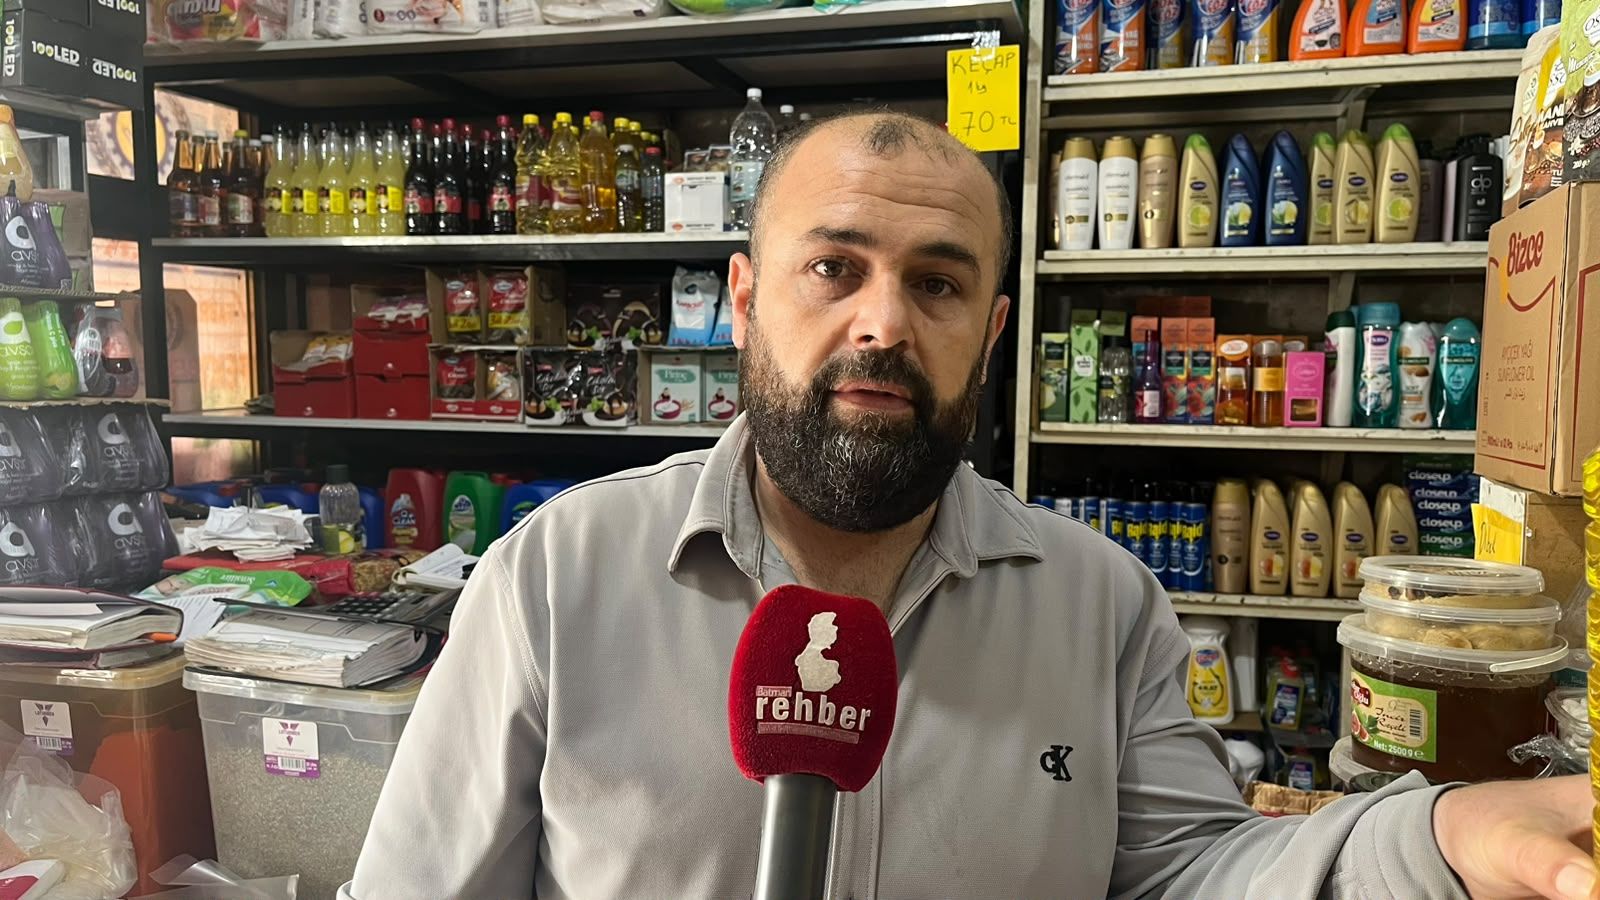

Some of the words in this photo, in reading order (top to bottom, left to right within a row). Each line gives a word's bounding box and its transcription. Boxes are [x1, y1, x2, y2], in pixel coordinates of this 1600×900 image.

[2, 18, 16, 77] 100LED
[31, 40, 81, 67] 100LED
[92, 57, 137, 82] 100LED
[960, 110, 995, 137] 70
[1506, 230, 1545, 277] Bizce
[1408, 469, 1452, 482] closeup
[1417, 499, 1461, 512] closeup
[1419, 517, 1464, 530] closeup
[1420, 534, 1463, 546] closeup
[757, 686, 791, 697] Batman
[756, 691, 872, 732] rehber
[1373, 739, 1388, 751] Net:
